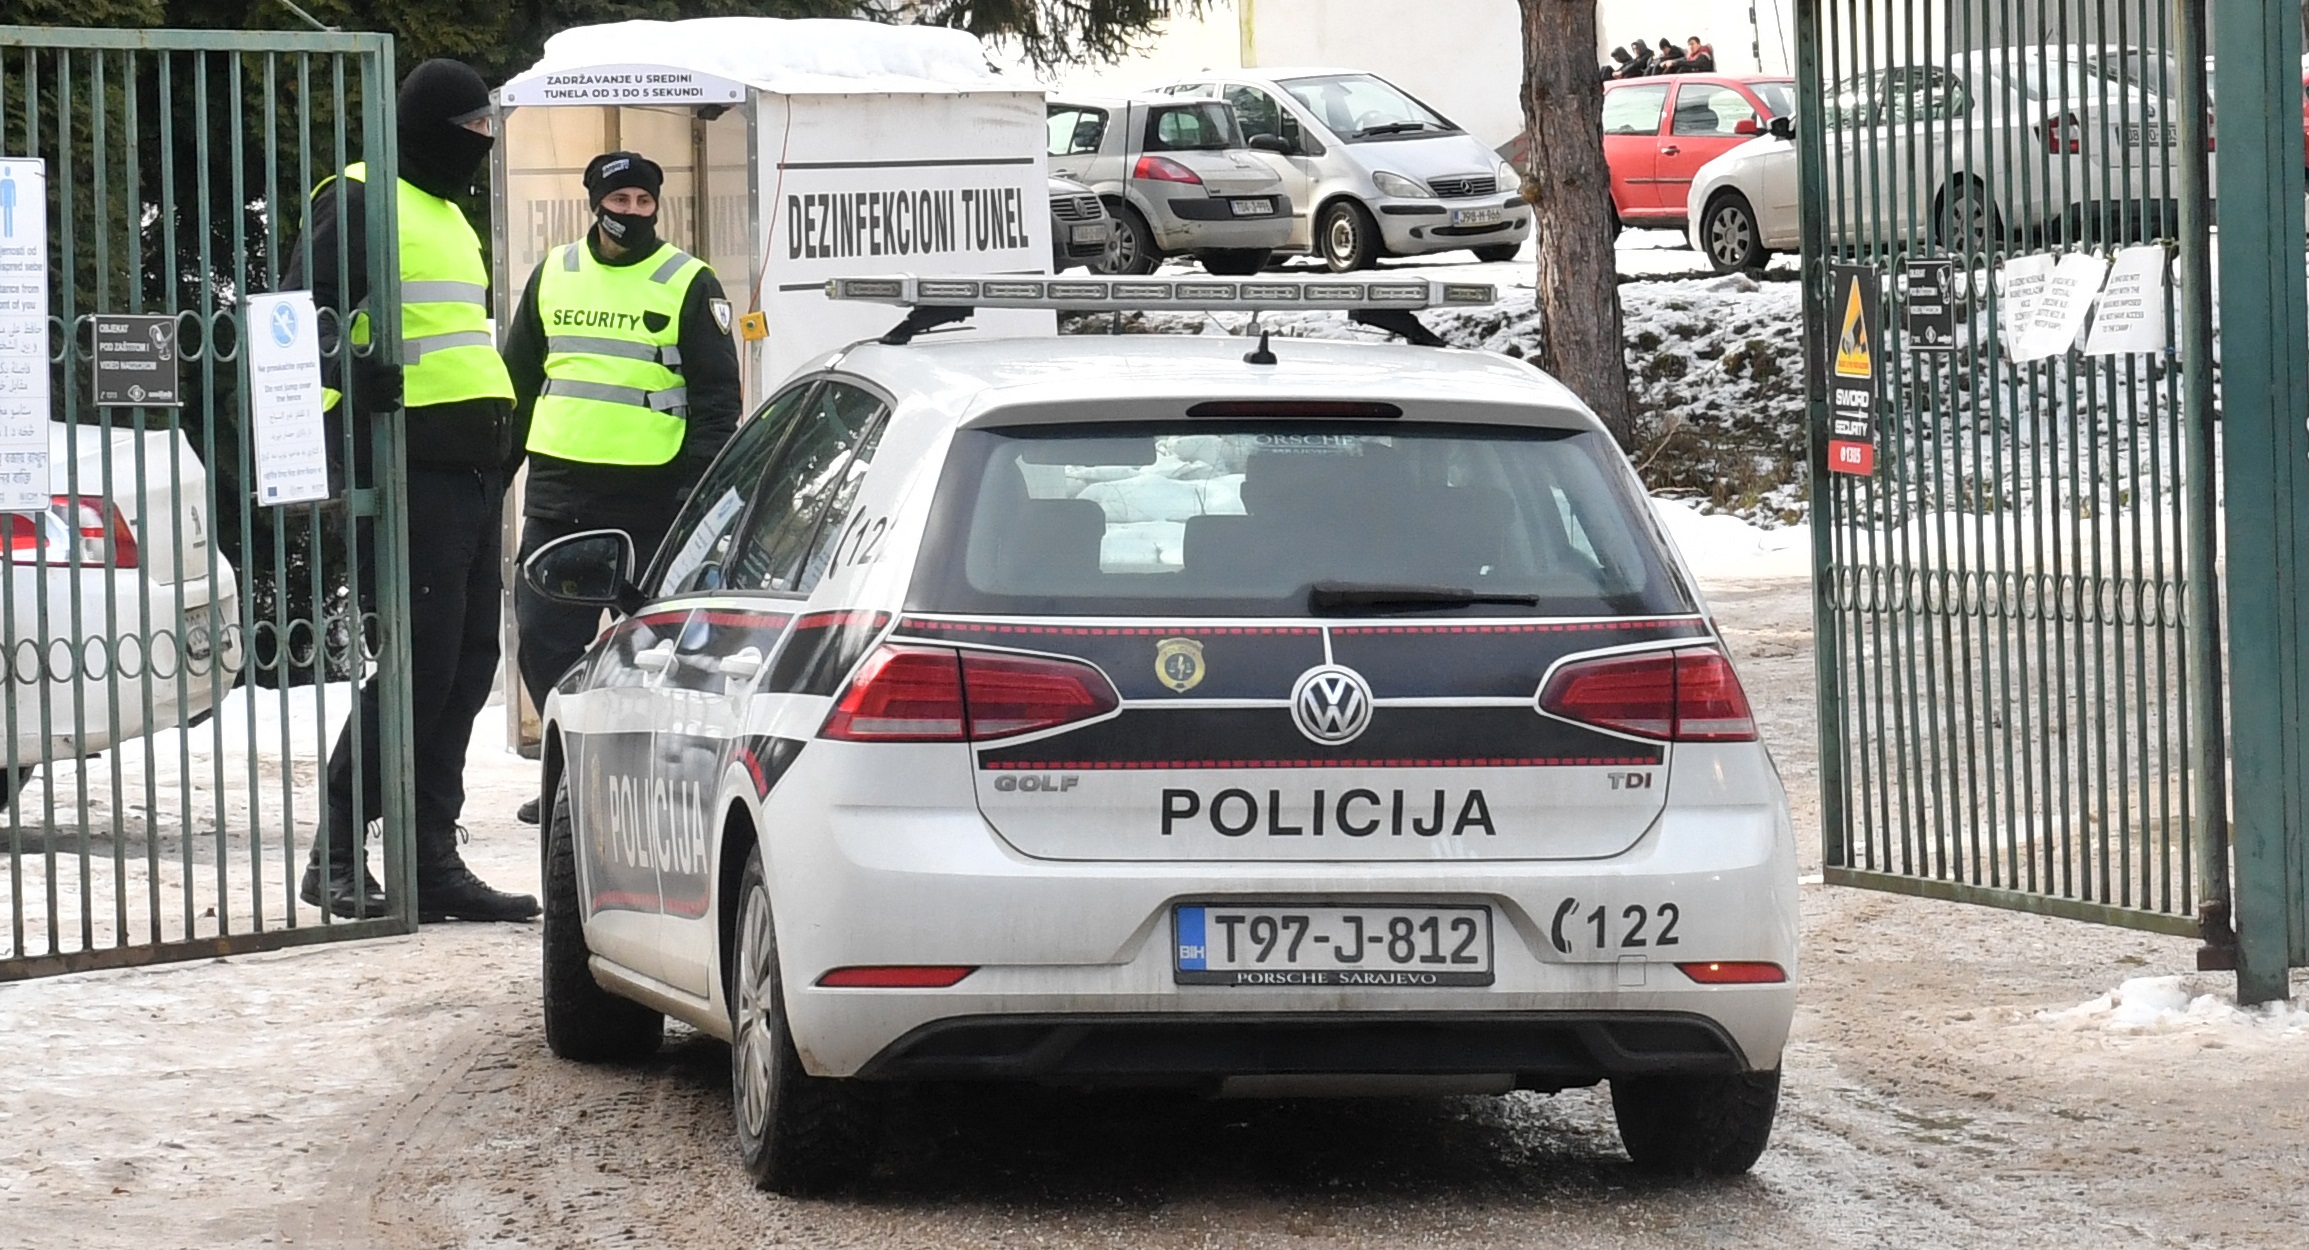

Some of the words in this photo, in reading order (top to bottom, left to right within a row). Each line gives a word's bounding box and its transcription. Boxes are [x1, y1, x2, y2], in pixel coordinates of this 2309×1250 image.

[547, 74, 632, 85] ZADRŽAVANJE
[635, 75, 643, 83] U
[646, 74, 692, 84] SREDINI
[544, 89, 588, 99] TUNELA
[592, 89, 609, 98] OD
[613, 89, 619, 97] 3
[623, 89, 639, 97] DO
[643, 89, 649, 97] 5
[652, 88, 703, 97] SEKUNDI
[787, 189, 955, 260] DEZINFEKCIONI
[961, 187, 1029, 252] TUNEL
[553, 309, 641, 331] SECURITY
[1836, 388, 1869, 407] SWORD
[1835, 419, 1868, 436] SECURITY
[994, 775, 1079, 793] GOLF
[1607, 772, 1652, 790] TDI
[1161, 788, 1496, 837] POLICIJA
[609, 774, 708, 875] POLICIJA
[1587, 902, 1679, 949] 122
[1179, 945, 1205, 959] BIH
[1215, 915, 1478, 964] T97-J-812
[1237, 972, 1328, 984] PORSCHE
[1339, 972, 1437, 984] SARAJEVO
